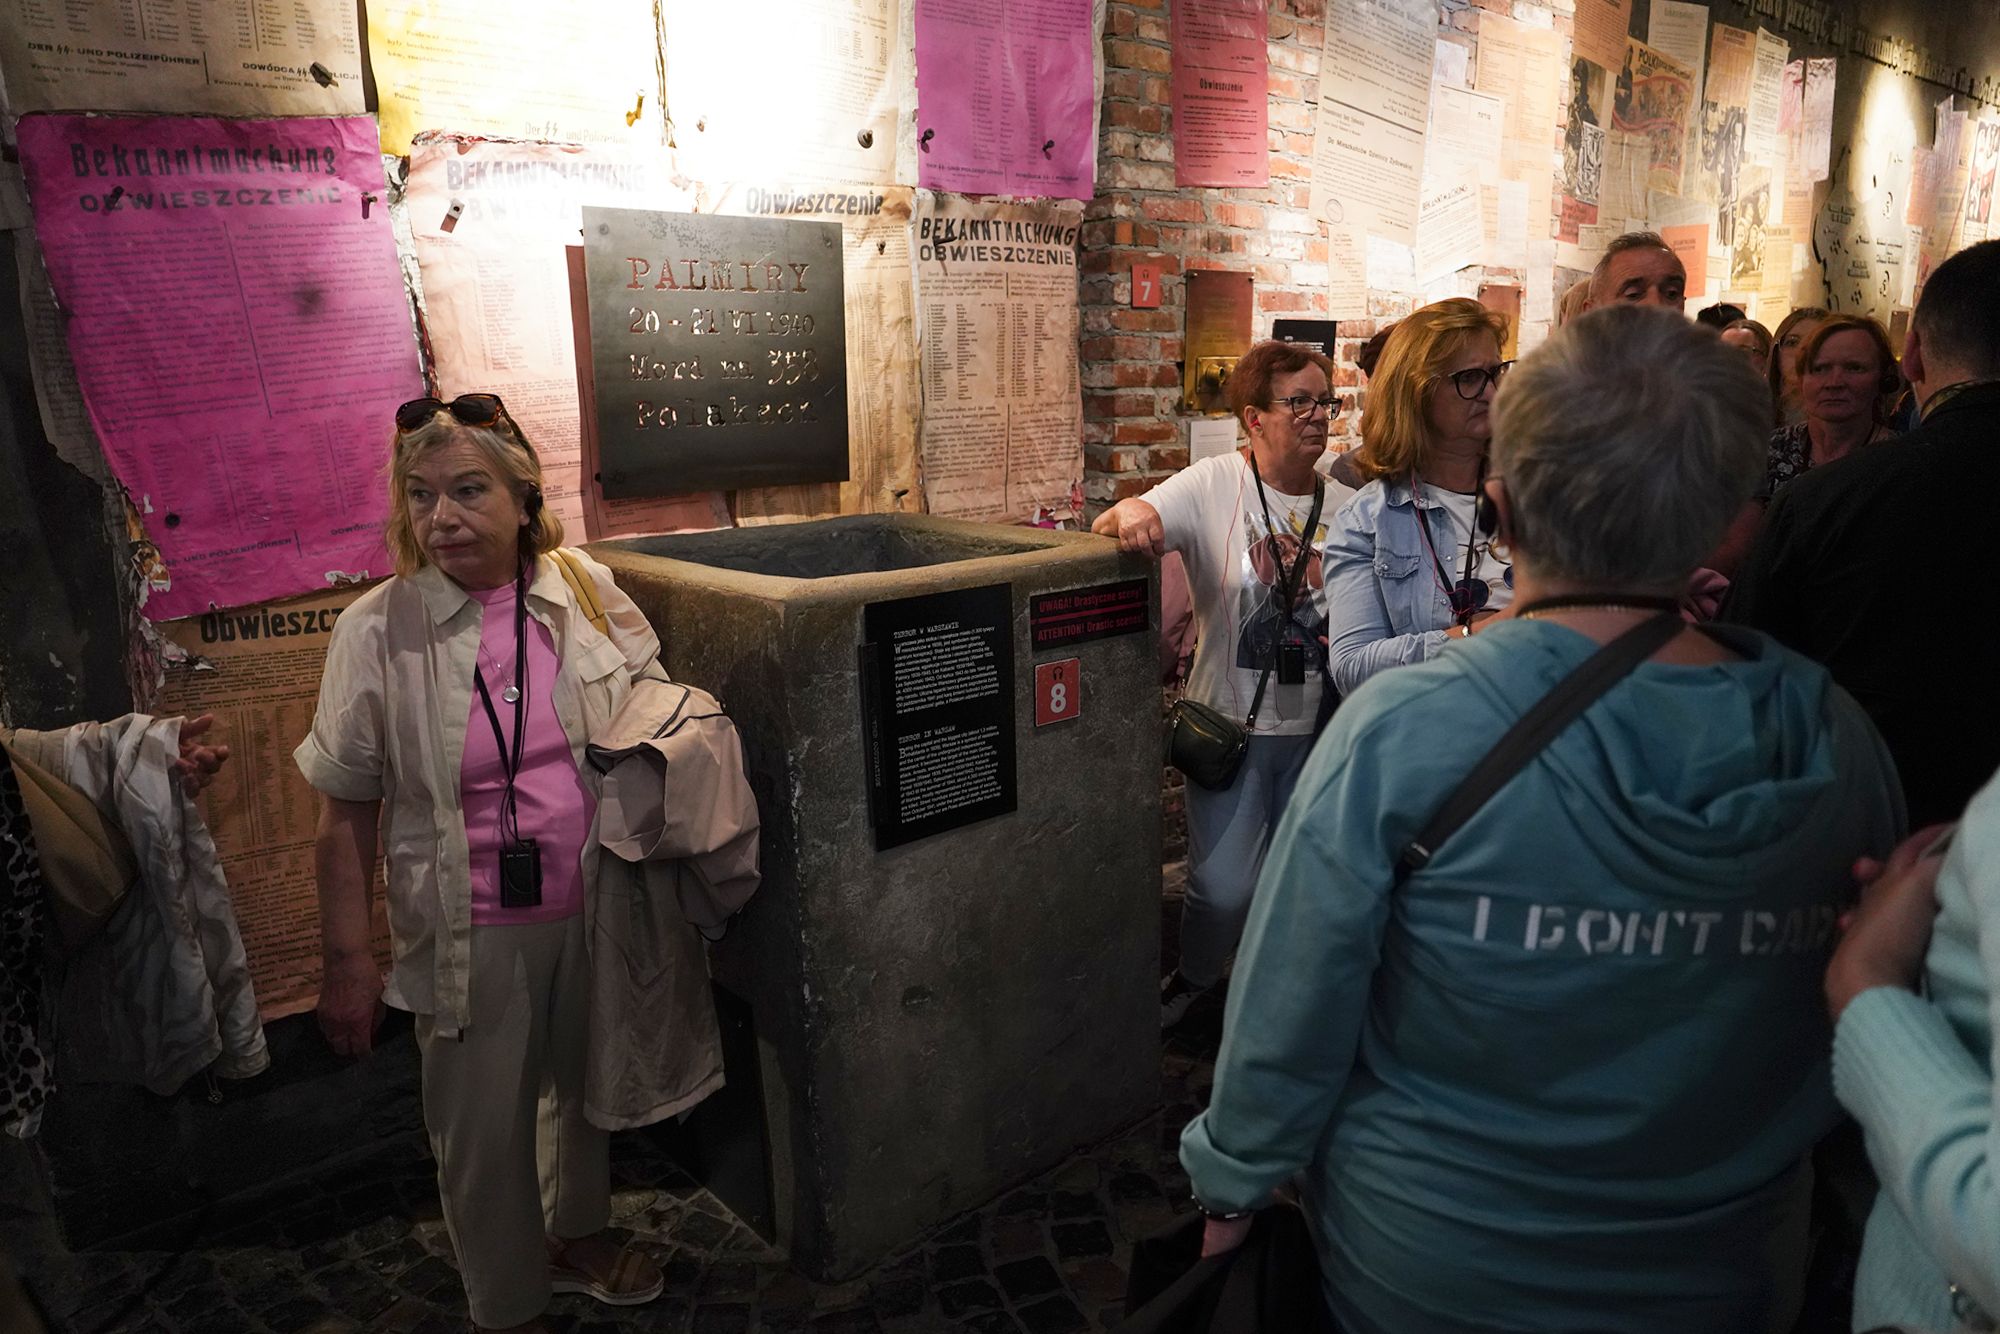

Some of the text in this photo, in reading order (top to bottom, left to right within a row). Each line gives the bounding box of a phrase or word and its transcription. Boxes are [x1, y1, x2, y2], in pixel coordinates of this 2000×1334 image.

[77, 48, 103, 57] UND
[107, 50, 200, 65] POLIZEIFÜHRER
[242, 61, 295, 74] DOWÓDCA
[71, 142, 337, 177] Bekanntmachung
[745, 188, 884, 215] Obwieszczenie
[920, 216, 1076, 247] BEKANNTMACHUNG
[919, 245, 1075, 266] OBWIESZCZENIE
[625, 256, 810, 294] PALMIRY
[1140, 282, 1152, 302] 7
[628, 306, 661, 335] 20
[690, 307, 721, 335] 21
[728, 310, 760, 336] VI
[765, 311, 816, 337] 1940
[628, 353, 706, 382] Mord
[1039, 596, 1071, 613] UWAGA!
[200, 608, 345, 644] Obwieszcz
[1038, 622, 1084, 640] ATTENTION!
[1049, 681, 1068, 715] 8
[1473, 896, 1838, 956] I DON'T CAR
